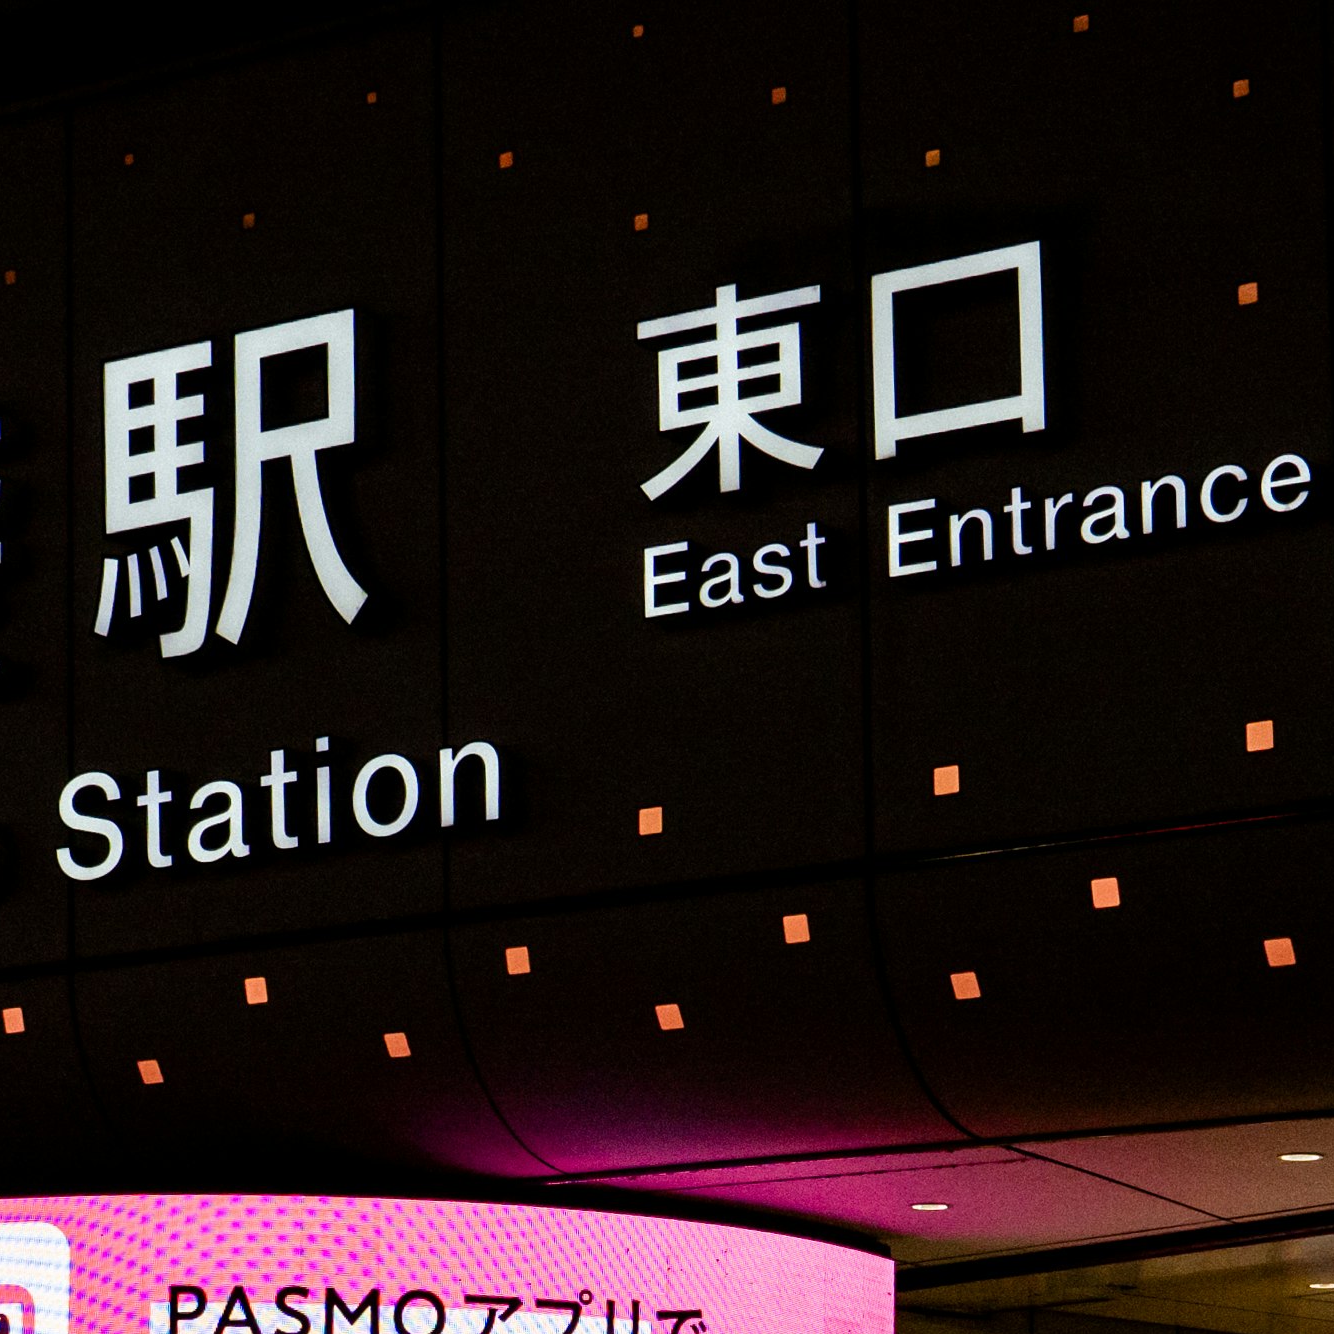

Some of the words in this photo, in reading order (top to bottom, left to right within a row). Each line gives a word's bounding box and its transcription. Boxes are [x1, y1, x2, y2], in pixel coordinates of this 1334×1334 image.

[637, 240, 1046, 502] 東口
[643, 523, 827, 619] East
[888, 452, 1312, 578] Entrance
[55, 736, 501, 881] Station
